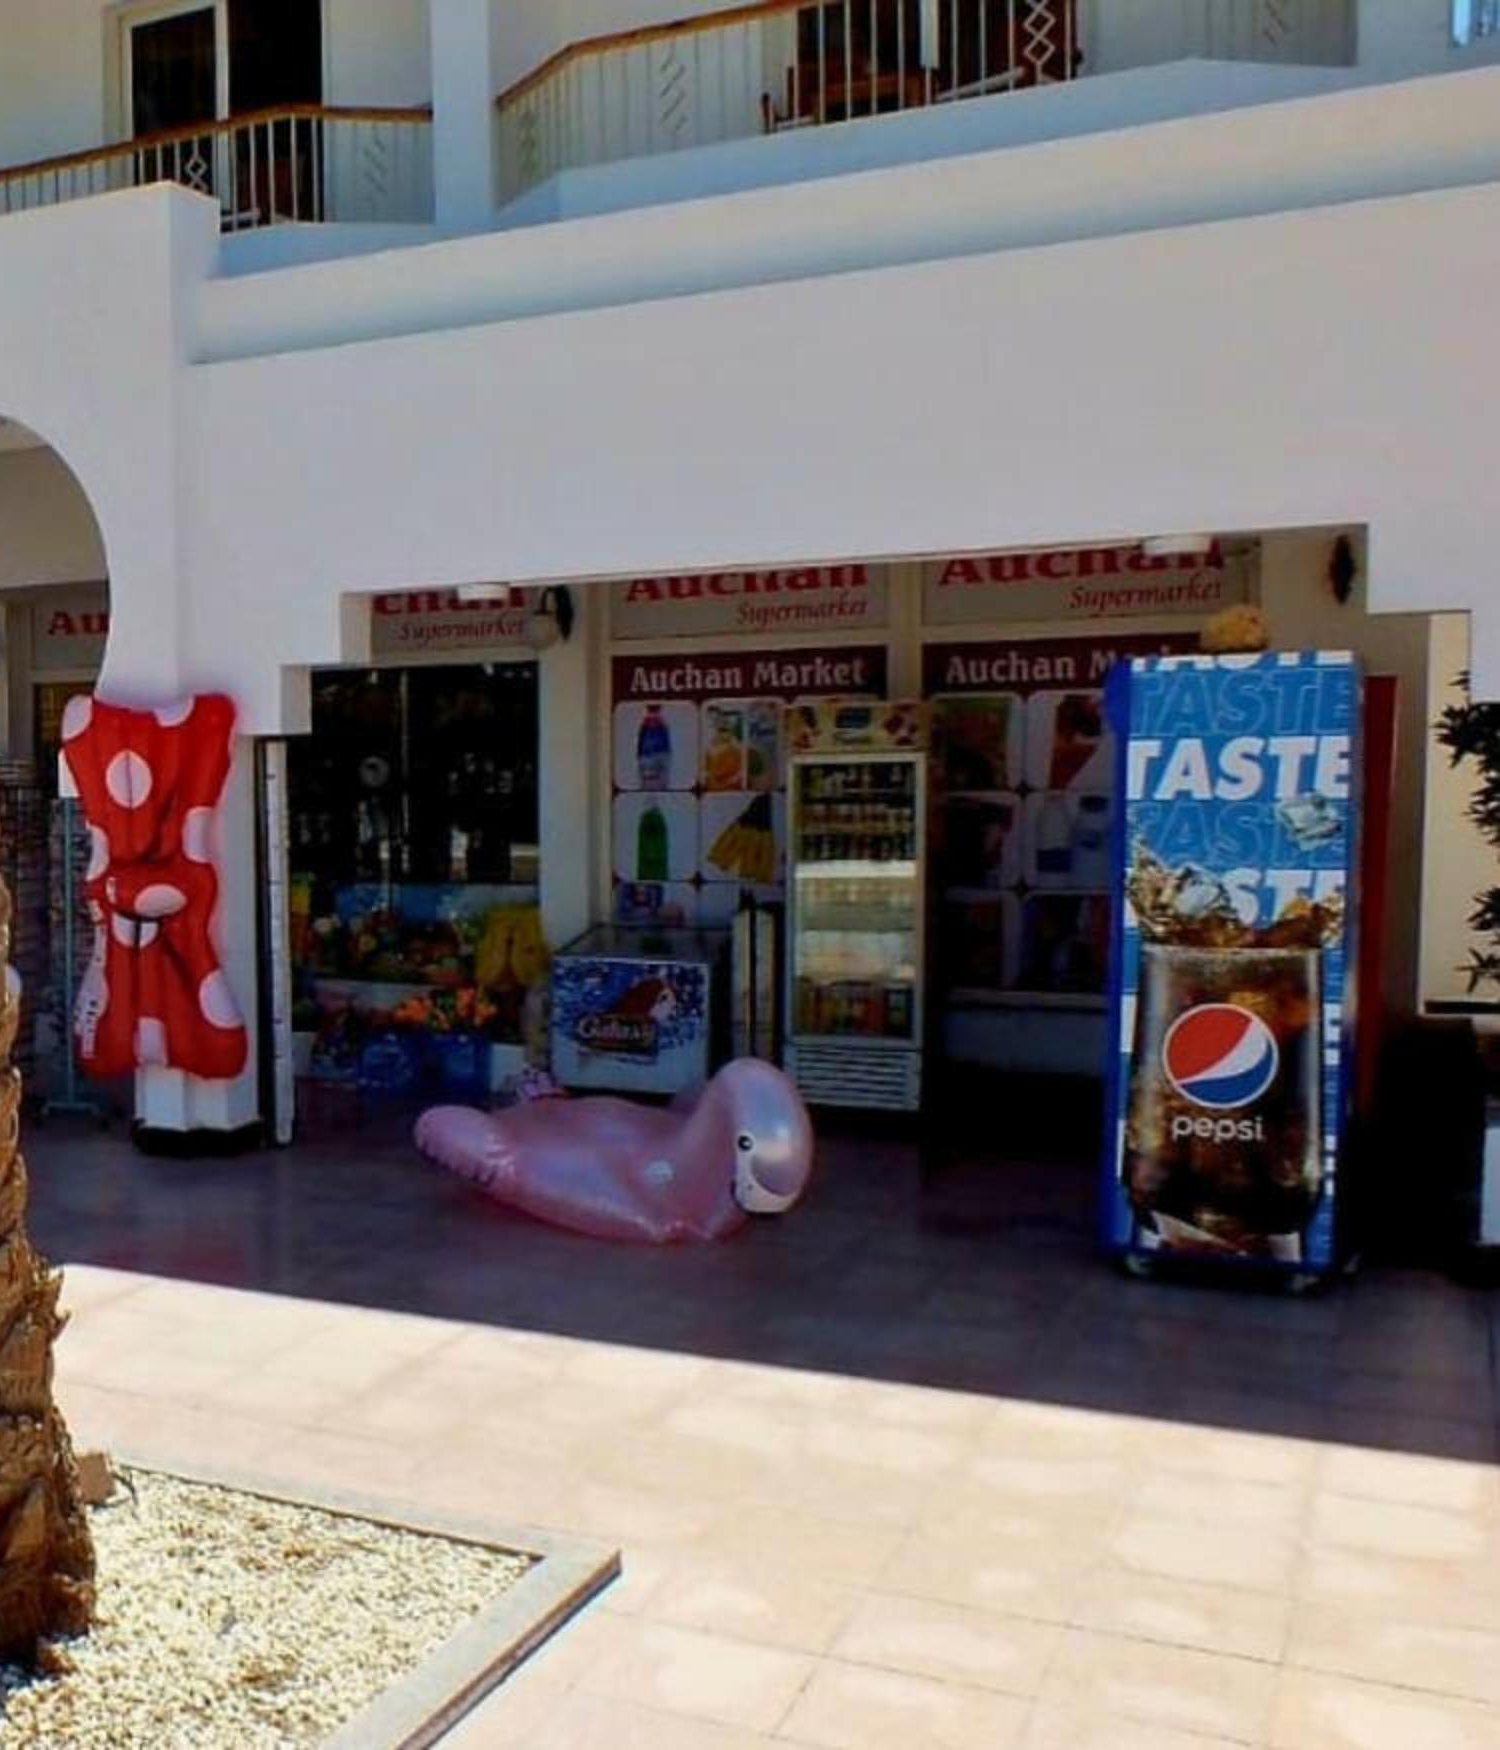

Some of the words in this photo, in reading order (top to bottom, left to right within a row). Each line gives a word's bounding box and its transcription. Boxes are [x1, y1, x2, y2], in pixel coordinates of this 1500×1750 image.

[736, 591, 869, 626] Supermarket
[1069, 571, 1223, 611] Supermarket
[630, 661, 742, 692] Auchan
[752, 656, 865, 688] Market
[946, 650, 1075, 684] Auchan
[1129, 667, 1350, 736] TASTE
[1126, 735, 1349, 800] TASTE
[1171, 1115, 1263, 1143] pepsi
